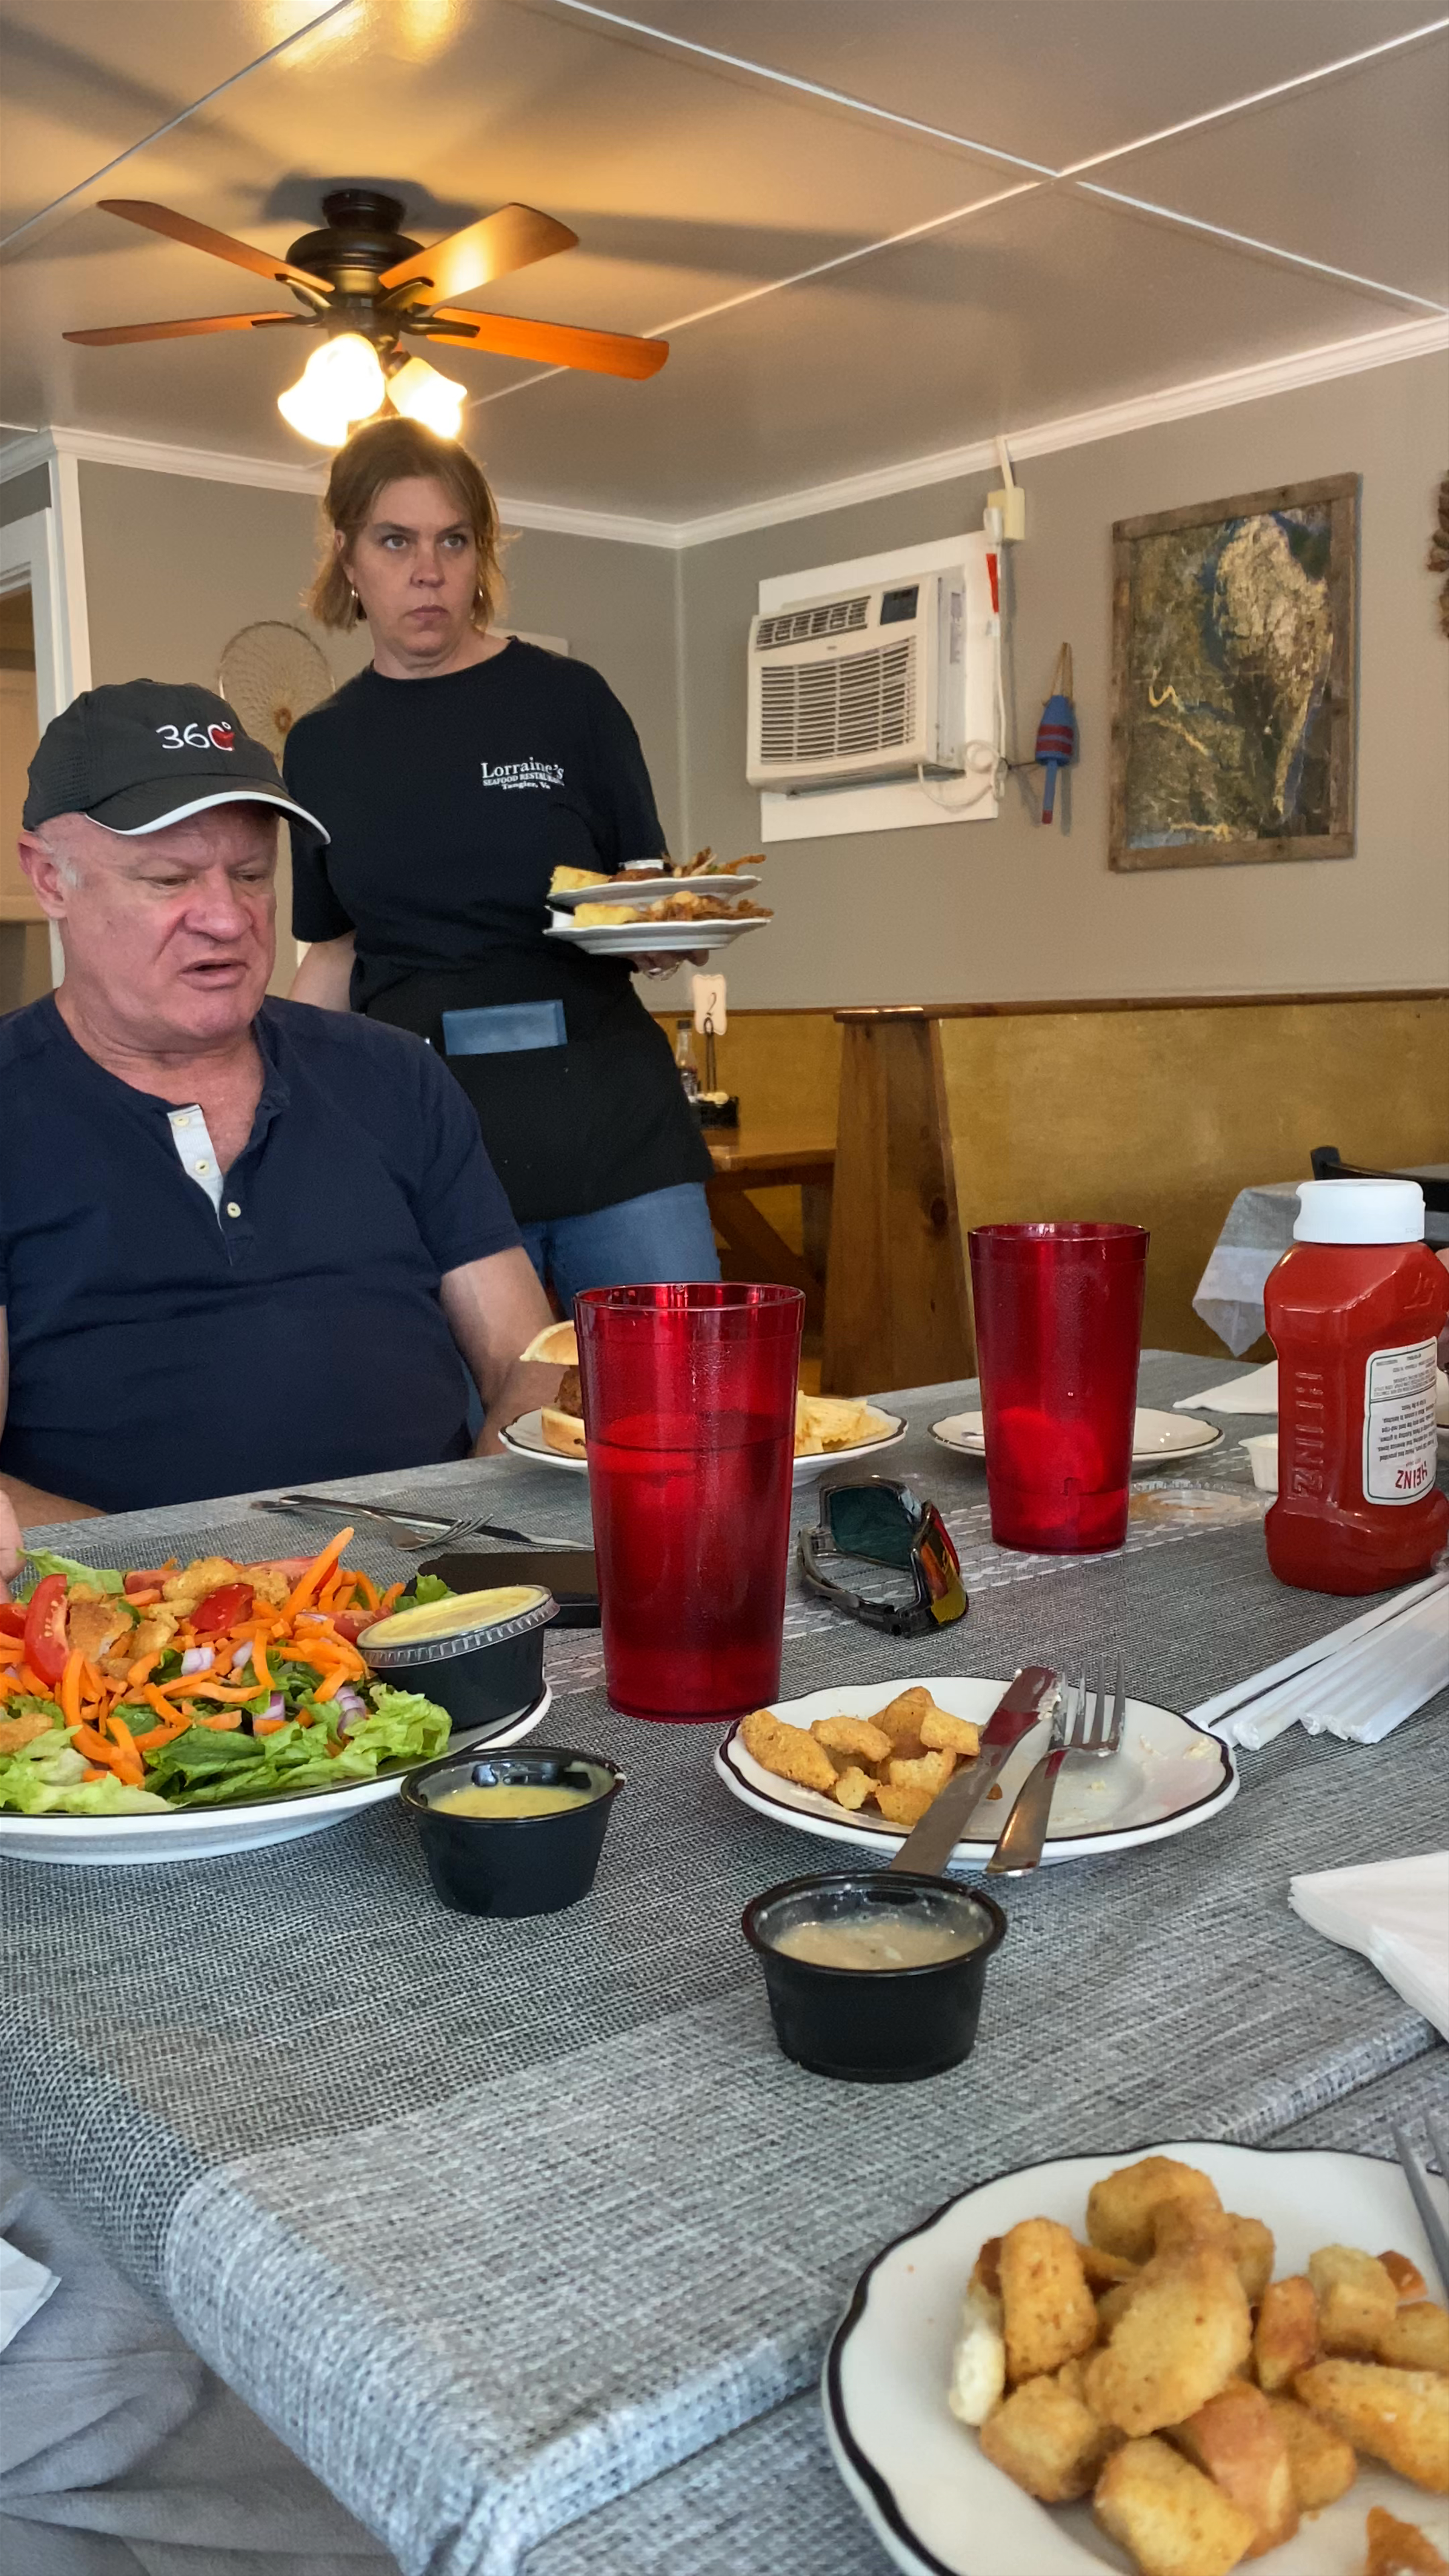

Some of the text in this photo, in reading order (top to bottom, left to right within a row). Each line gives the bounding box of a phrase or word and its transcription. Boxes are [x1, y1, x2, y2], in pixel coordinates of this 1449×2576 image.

[480, 757, 564, 780] Lorraine's
[483, 772, 565, 786] SEAFOOD RESTAU
[1395, 1461, 1428, 1490] HEINZ
